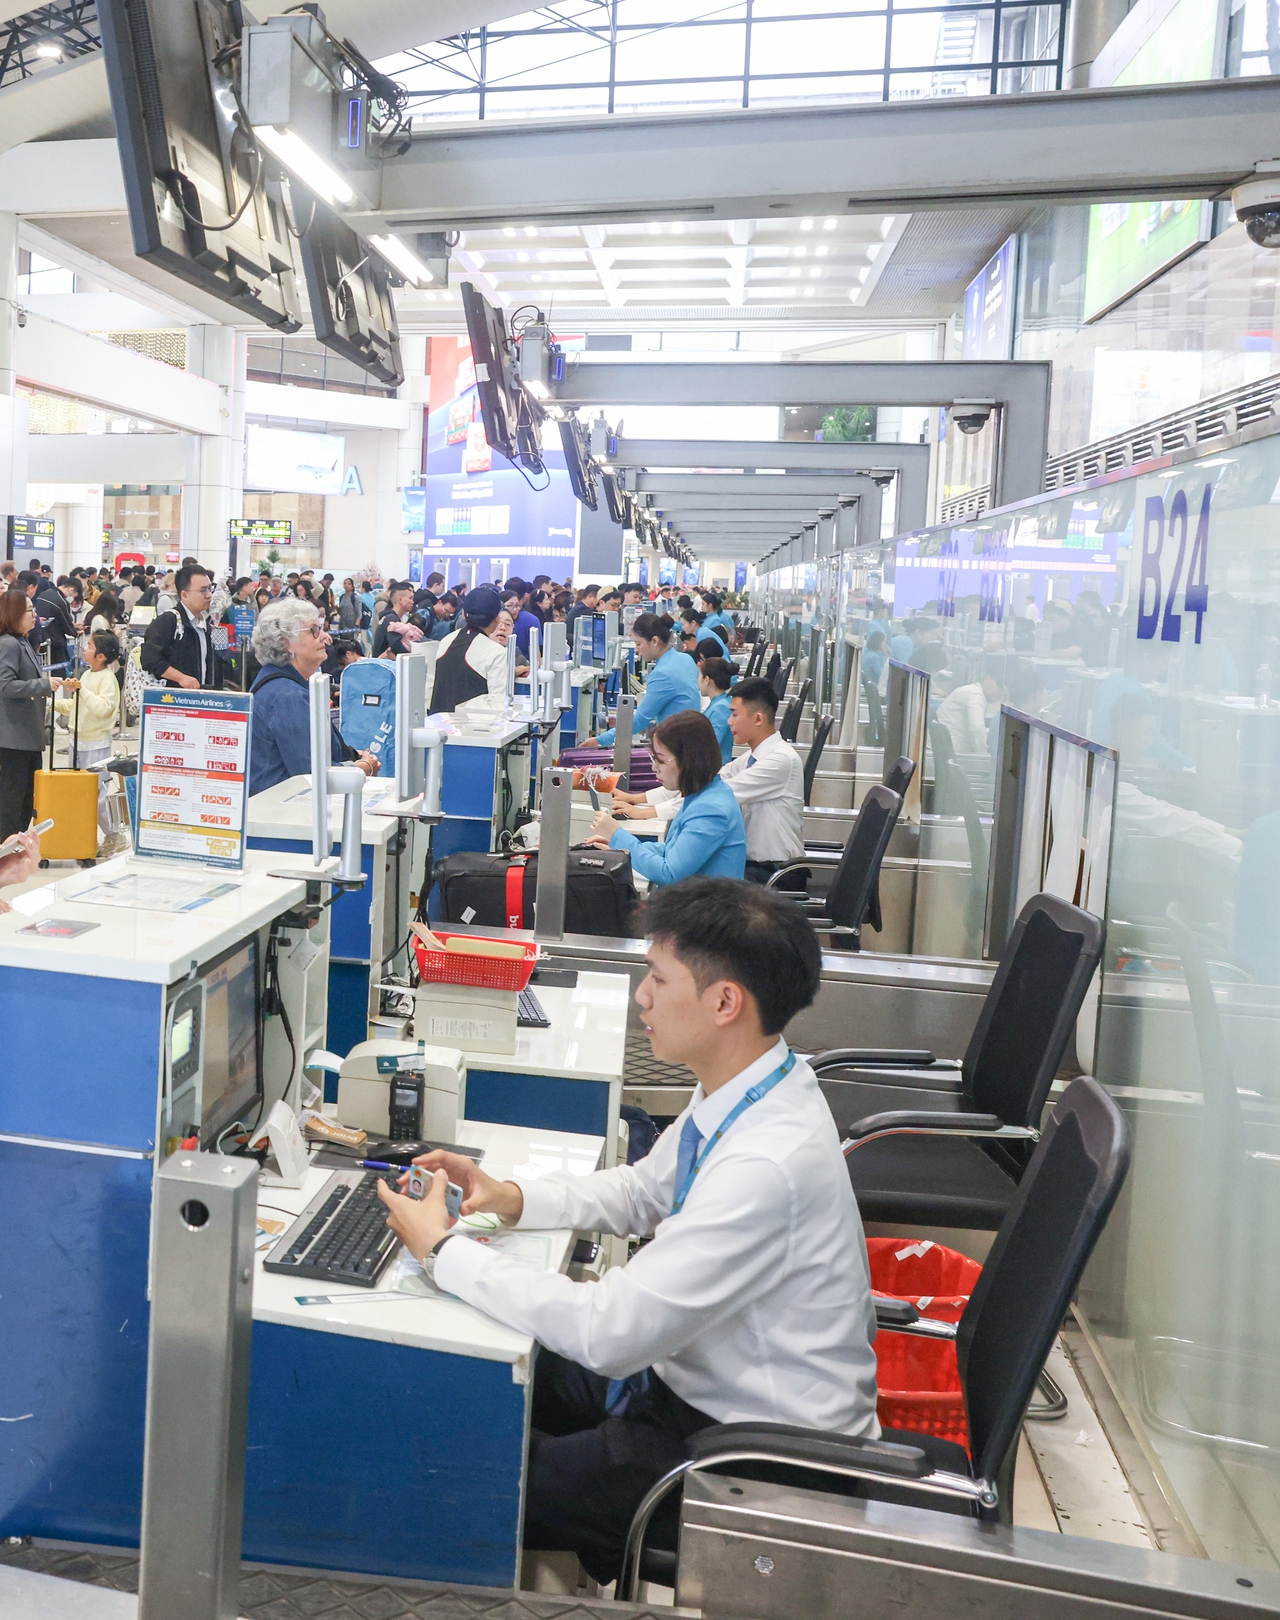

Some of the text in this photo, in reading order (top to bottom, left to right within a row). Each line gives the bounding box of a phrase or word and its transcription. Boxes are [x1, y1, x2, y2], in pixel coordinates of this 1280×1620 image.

[342, 465, 364, 495] A
[1137, 483, 1211, 644] B24
[174, 696, 224, 707] Vietnam Airlines
